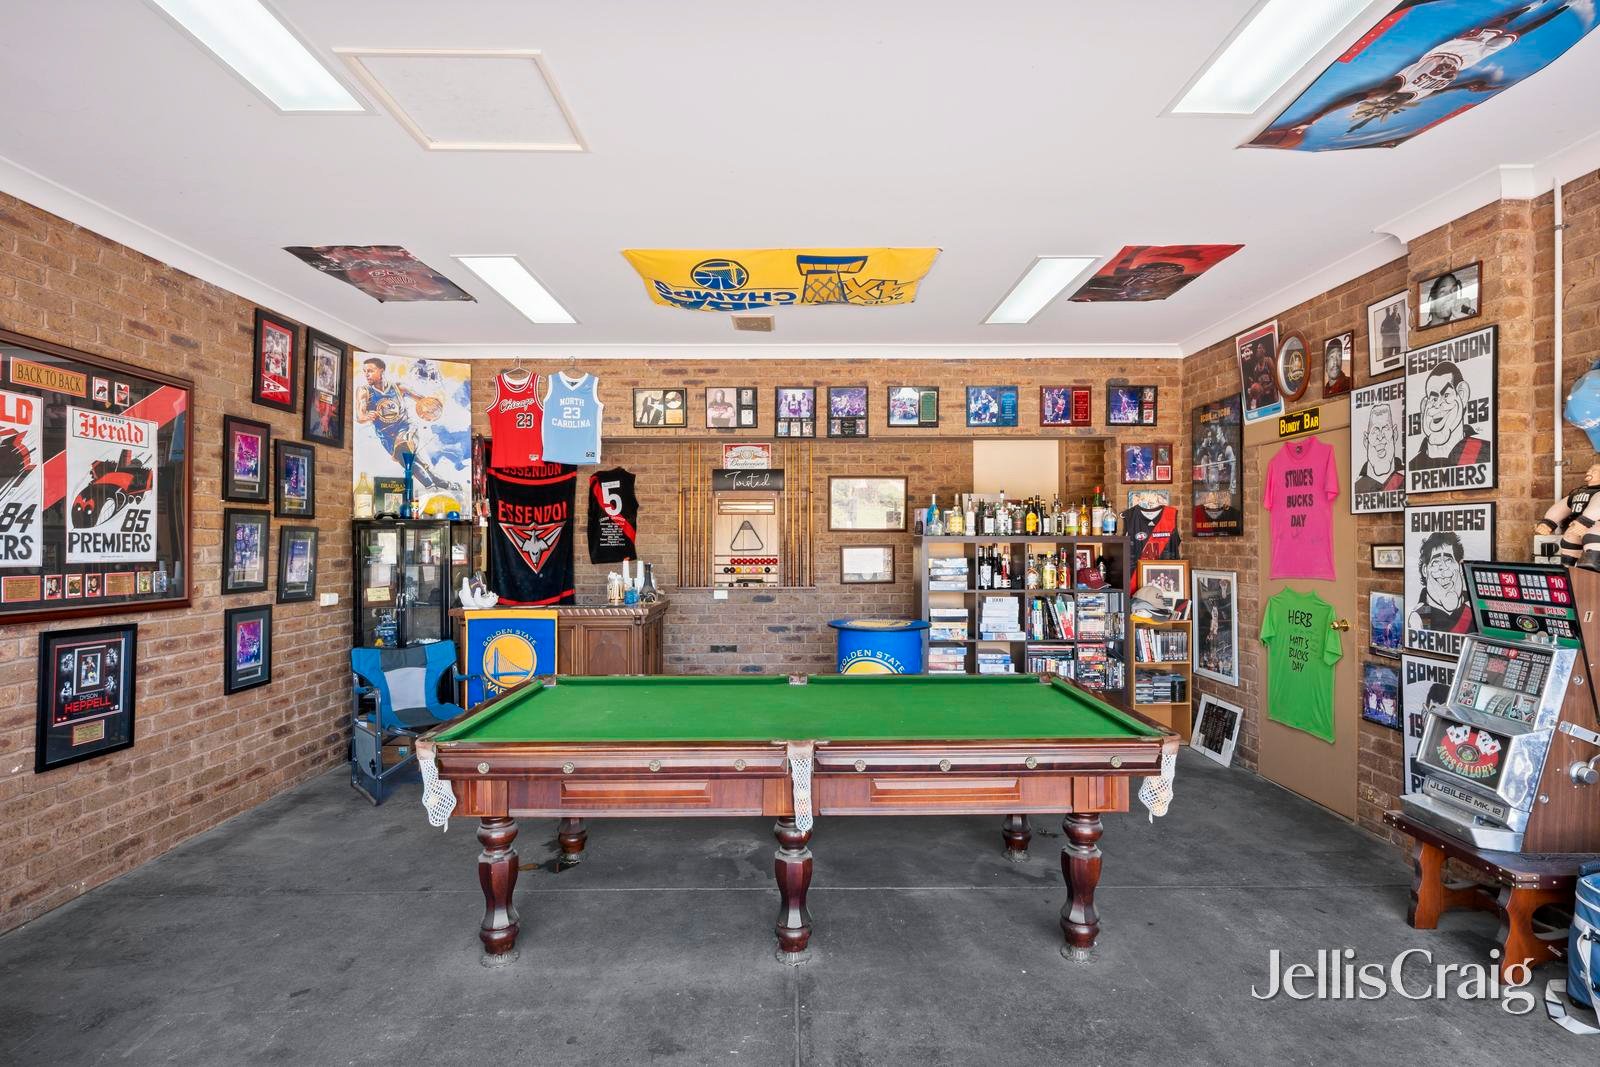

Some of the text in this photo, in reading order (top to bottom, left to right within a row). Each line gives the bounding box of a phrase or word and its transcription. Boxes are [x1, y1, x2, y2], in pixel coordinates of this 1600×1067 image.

[653, 279, 797, 302] CHAMPS
[1408, 332, 1491, 376] ESSENDON
[16, 363, 81, 391] BACK TO BACK
[500, 398, 535, 414] Chicago
[560, 397, 585, 407] NORTH
[1355, 381, 1406, 409] BOMBER
[516, 412, 534, 429] 23
[563, 407, 581, 419] 23
[1467, 397, 1489, 425] 93
[79, 412, 144, 444] Herald
[551, 418, 591, 429] CAROLINA
[1280, 413, 1319, 435] BUNDY BAR
[725, 471, 771, 490] Twisted
[1411, 463, 1487, 491] PREMIERS
[601, 480, 623, 516] 5
[1286, 494, 1314, 509] BUCKS
[1355, 489, 1408, 511] PREMIER
[0, 502, 38, 534] 84
[120, 508, 152, 533] 85
[1291, 514, 1307, 528] DAY
[1411, 508, 1486, 533] BOMBERS
[68, 532, 152, 554] PREMIERS
[1288, 609, 1312, 628] HERB
[482, 628, 538, 648] GOLDEN STATE
[1408, 628, 1463, 657] PREMIE
[840, 649, 906, 674] GOLDEN STATE
[1289, 647, 1309, 663] BUCKS
[1291, 660, 1305, 673] DAY
[1406, 660, 1456, 685] BOMBE
[64, 696, 112, 714] HEPPELL
[79, 693, 98, 702] DYSON
[1437, 745, 1497, 779] ACES GALORE
[1430, 782, 1473, 804] JUBILEE
[1474, 799, 1491, 812] MK.
